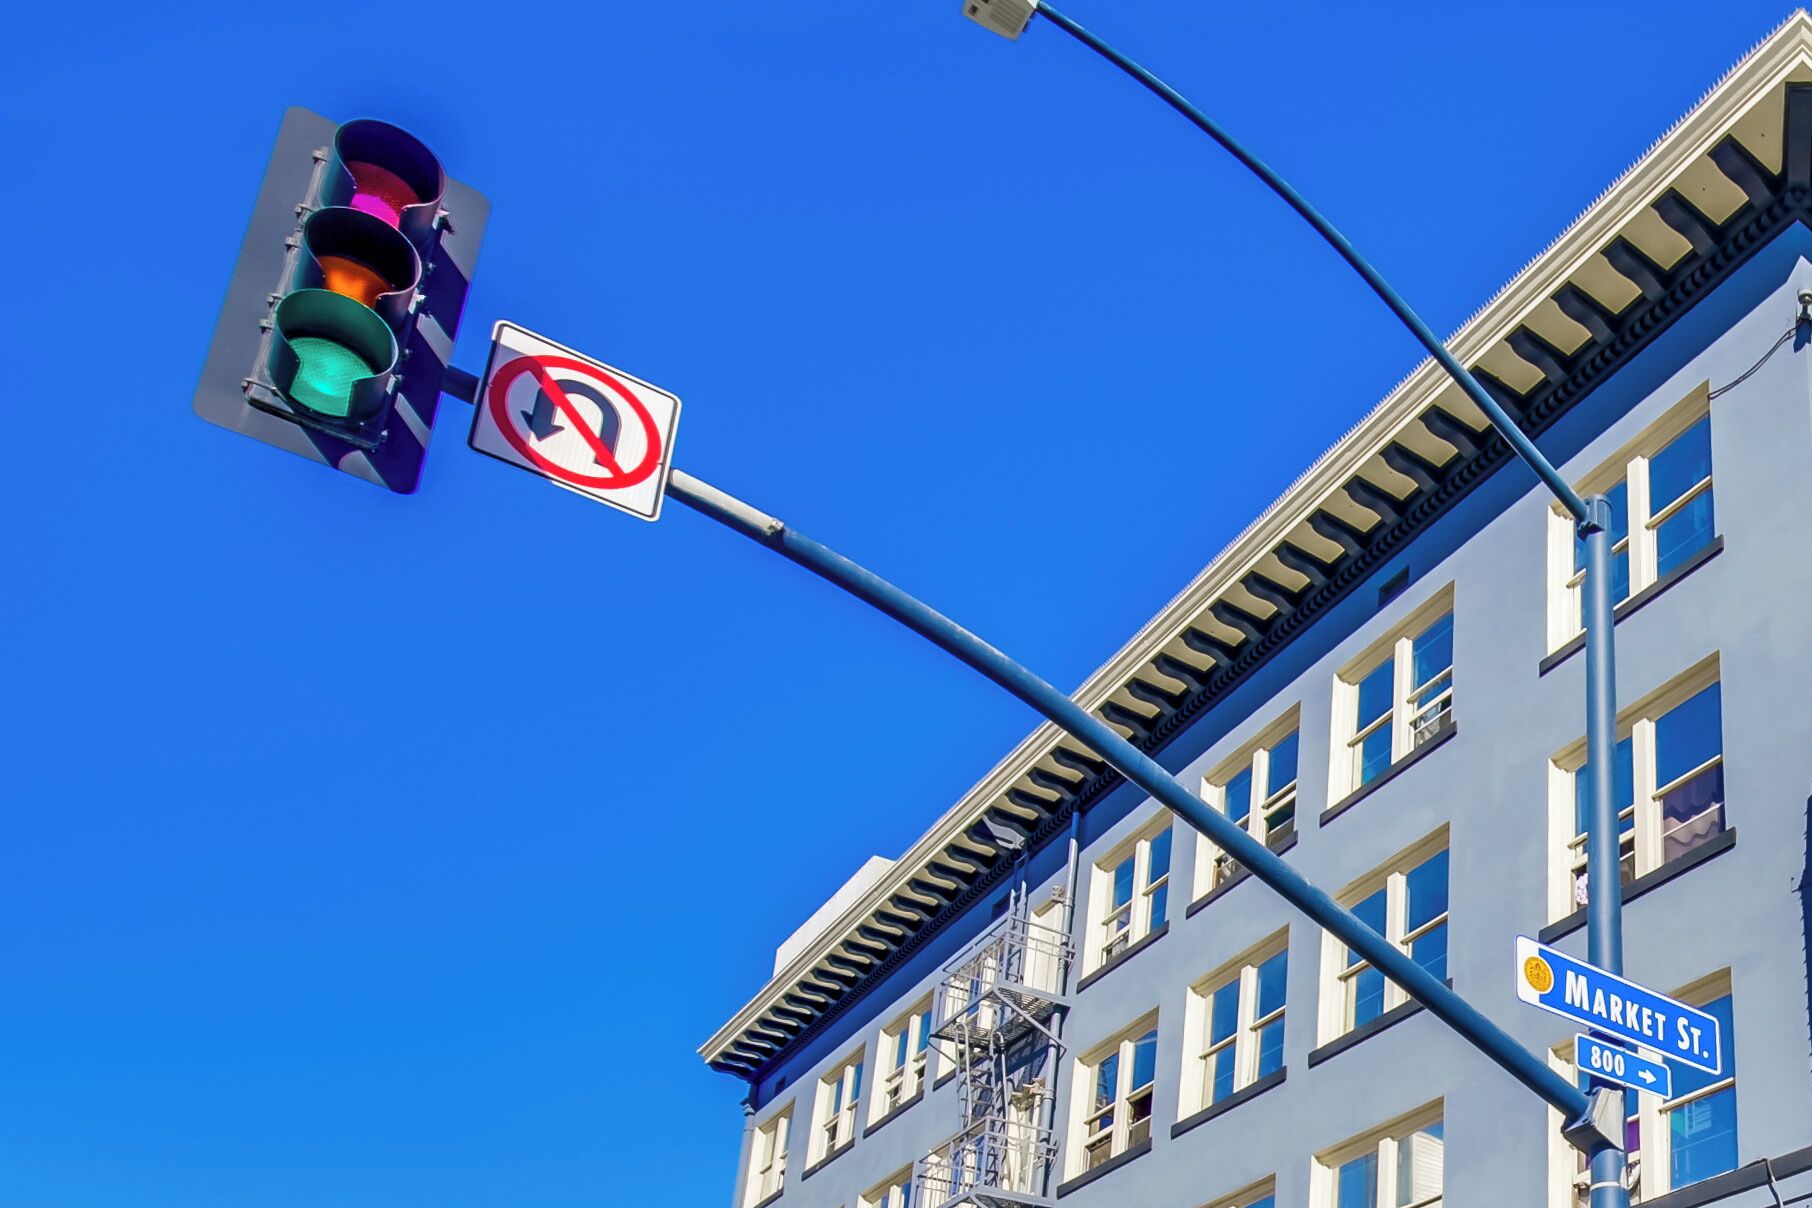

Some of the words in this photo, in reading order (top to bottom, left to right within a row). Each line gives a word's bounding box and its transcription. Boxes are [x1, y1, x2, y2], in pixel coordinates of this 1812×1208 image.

[1565, 970, 1666, 1041] MARKET
[1676, 1017, 1709, 1059] ST.
[1590, 1046, 1625, 1077] 800
